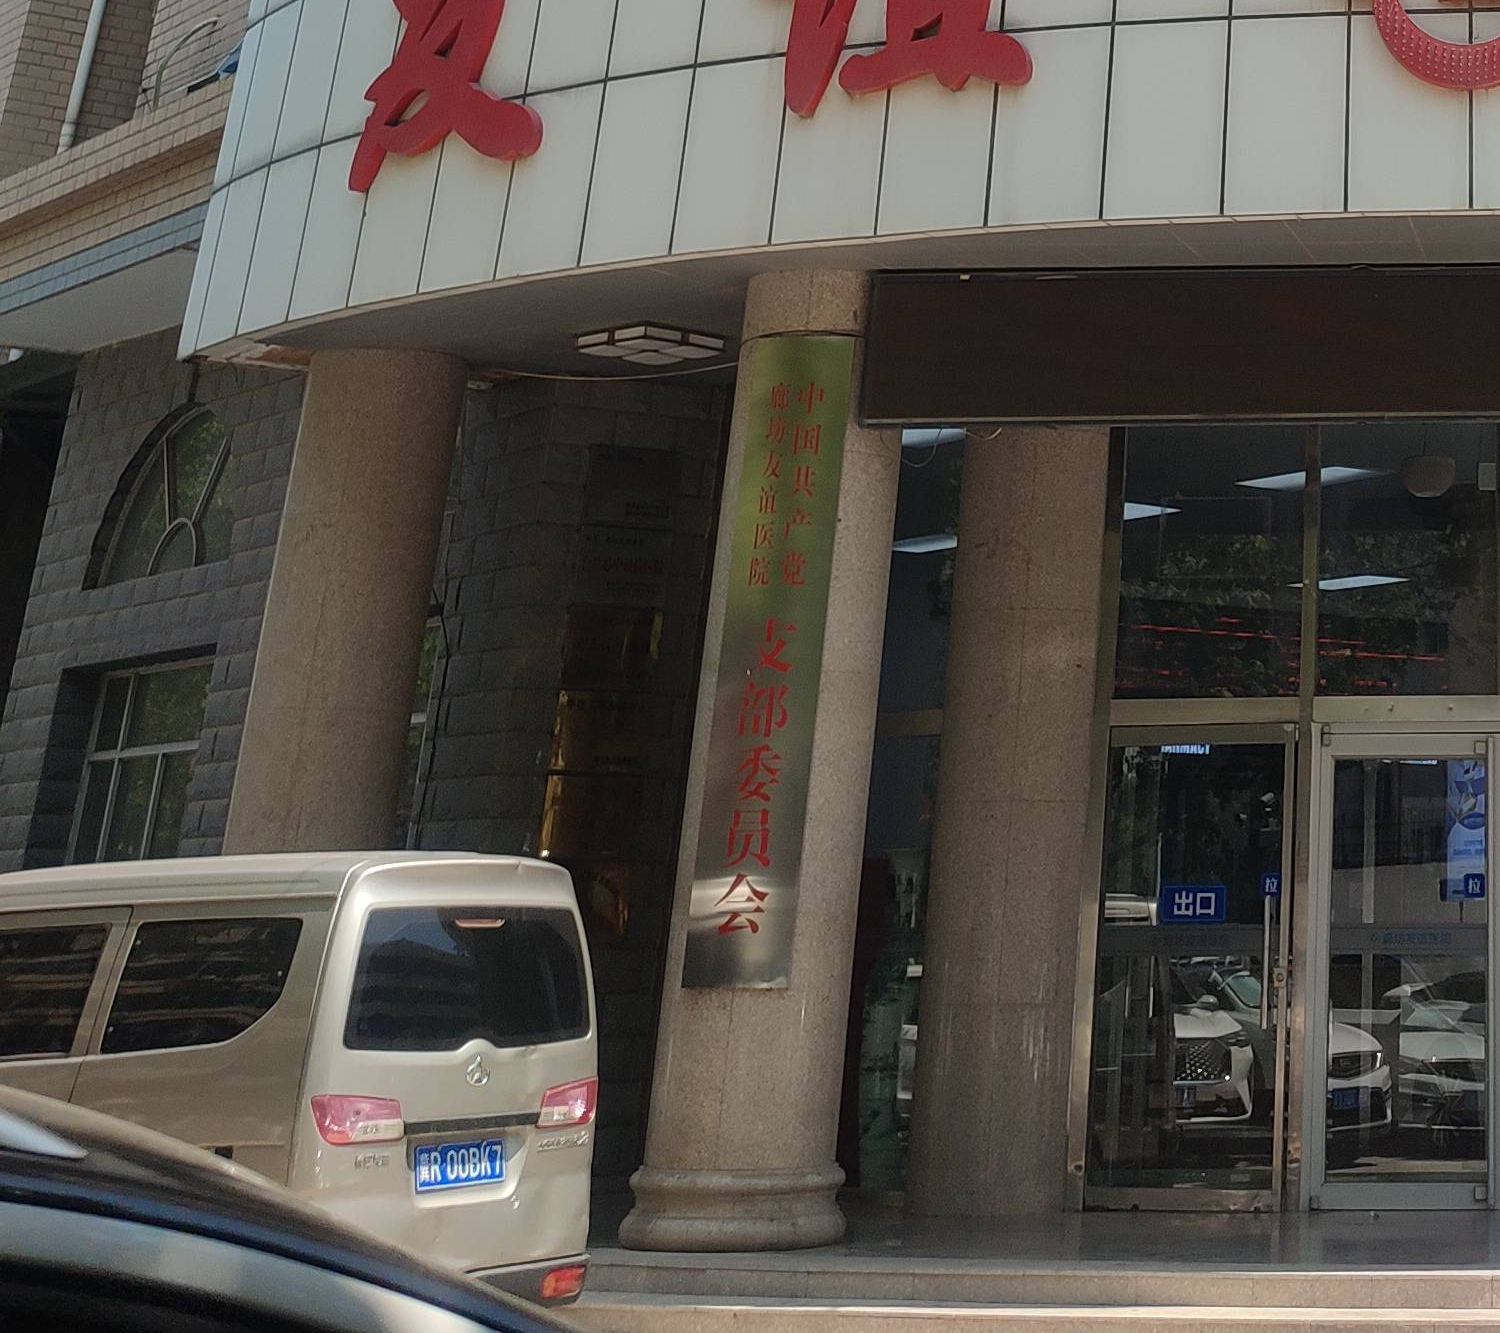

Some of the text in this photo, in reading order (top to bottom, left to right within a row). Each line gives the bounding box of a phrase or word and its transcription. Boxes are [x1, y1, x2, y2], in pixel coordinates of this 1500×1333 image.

[748, 381, 791, 587] 廊坊友谊医院
[780, 381, 825, 587] 中国共产党
[714, 617, 798, 934] 支部委员会
[1173, 890, 1216, 916] 出口
[1265, 876, 1278, 893] 拉
[1468, 877, 1481, 894] 拉
